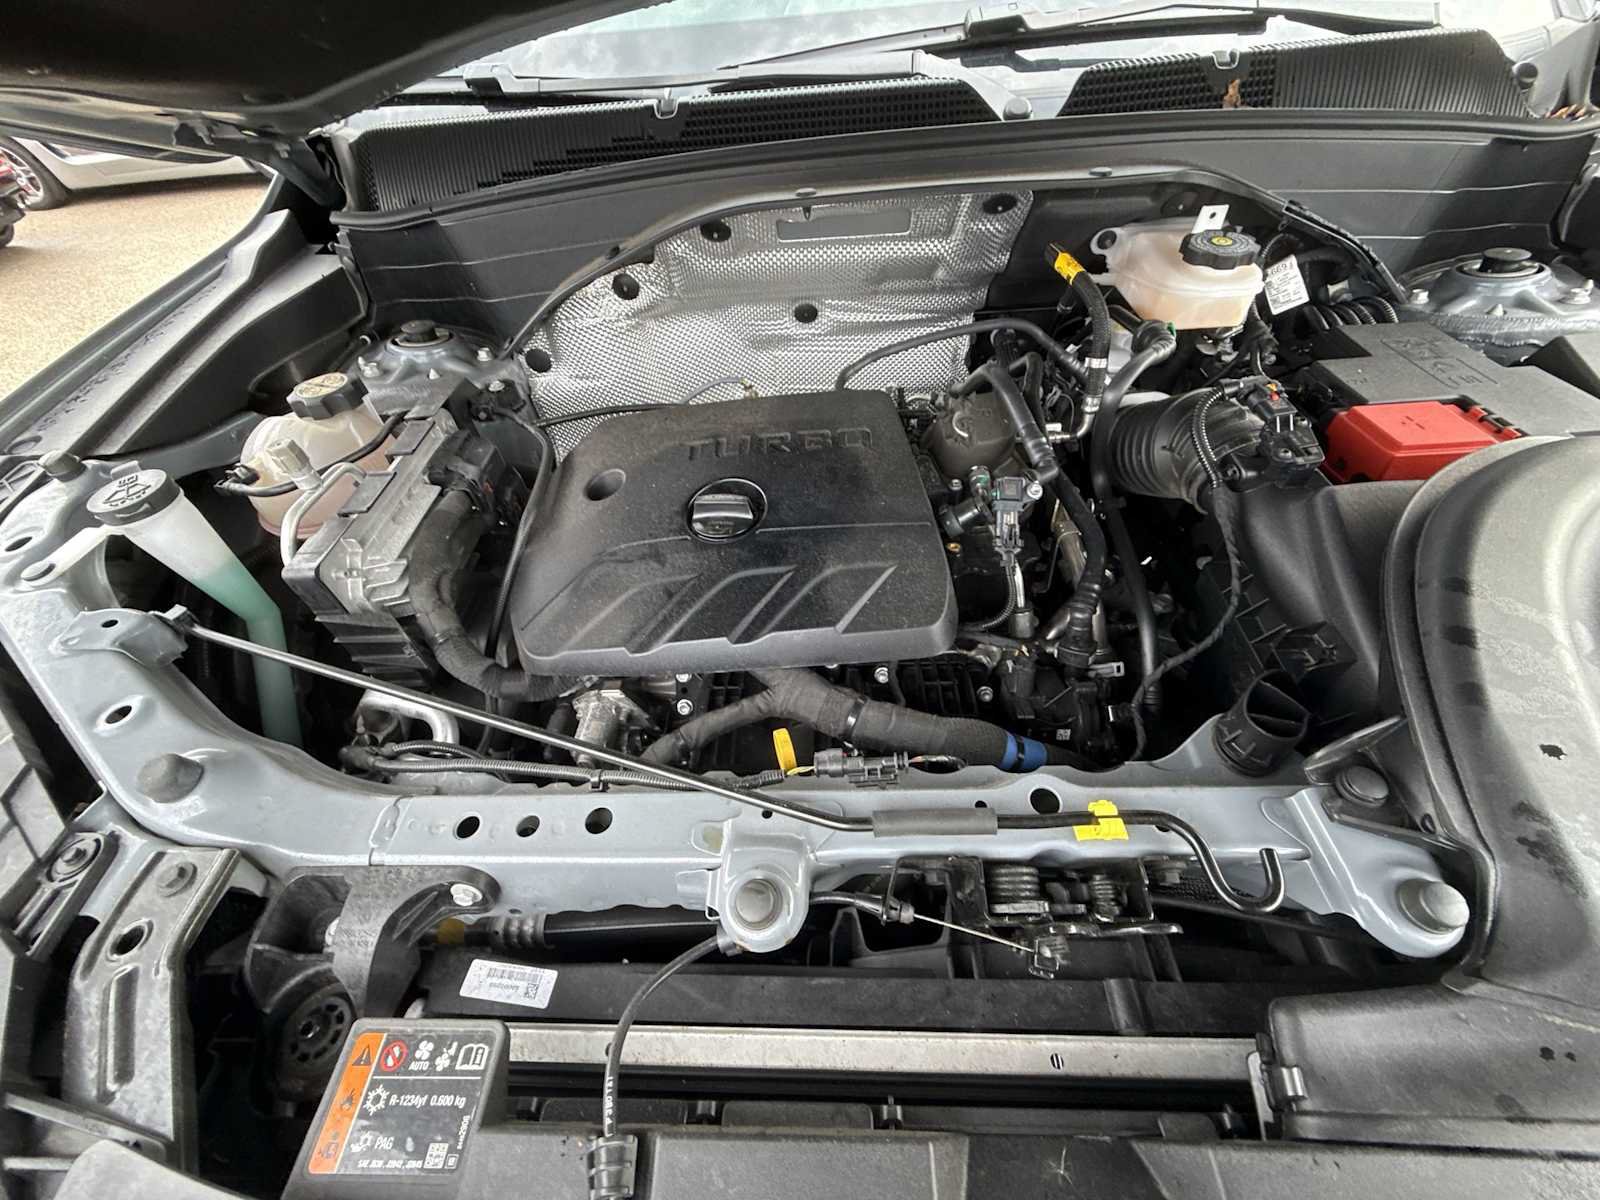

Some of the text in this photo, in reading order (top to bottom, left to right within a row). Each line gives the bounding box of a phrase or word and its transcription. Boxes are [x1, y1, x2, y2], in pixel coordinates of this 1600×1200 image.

[680, 427, 873, 461] TURBO
[408, 1061, 430, 1071] AUTO
[430, 1094, 454, 1107] 0.600
[454, 1095, 467, 1109] kg
[374, 1136, 395, 1150] PAG
